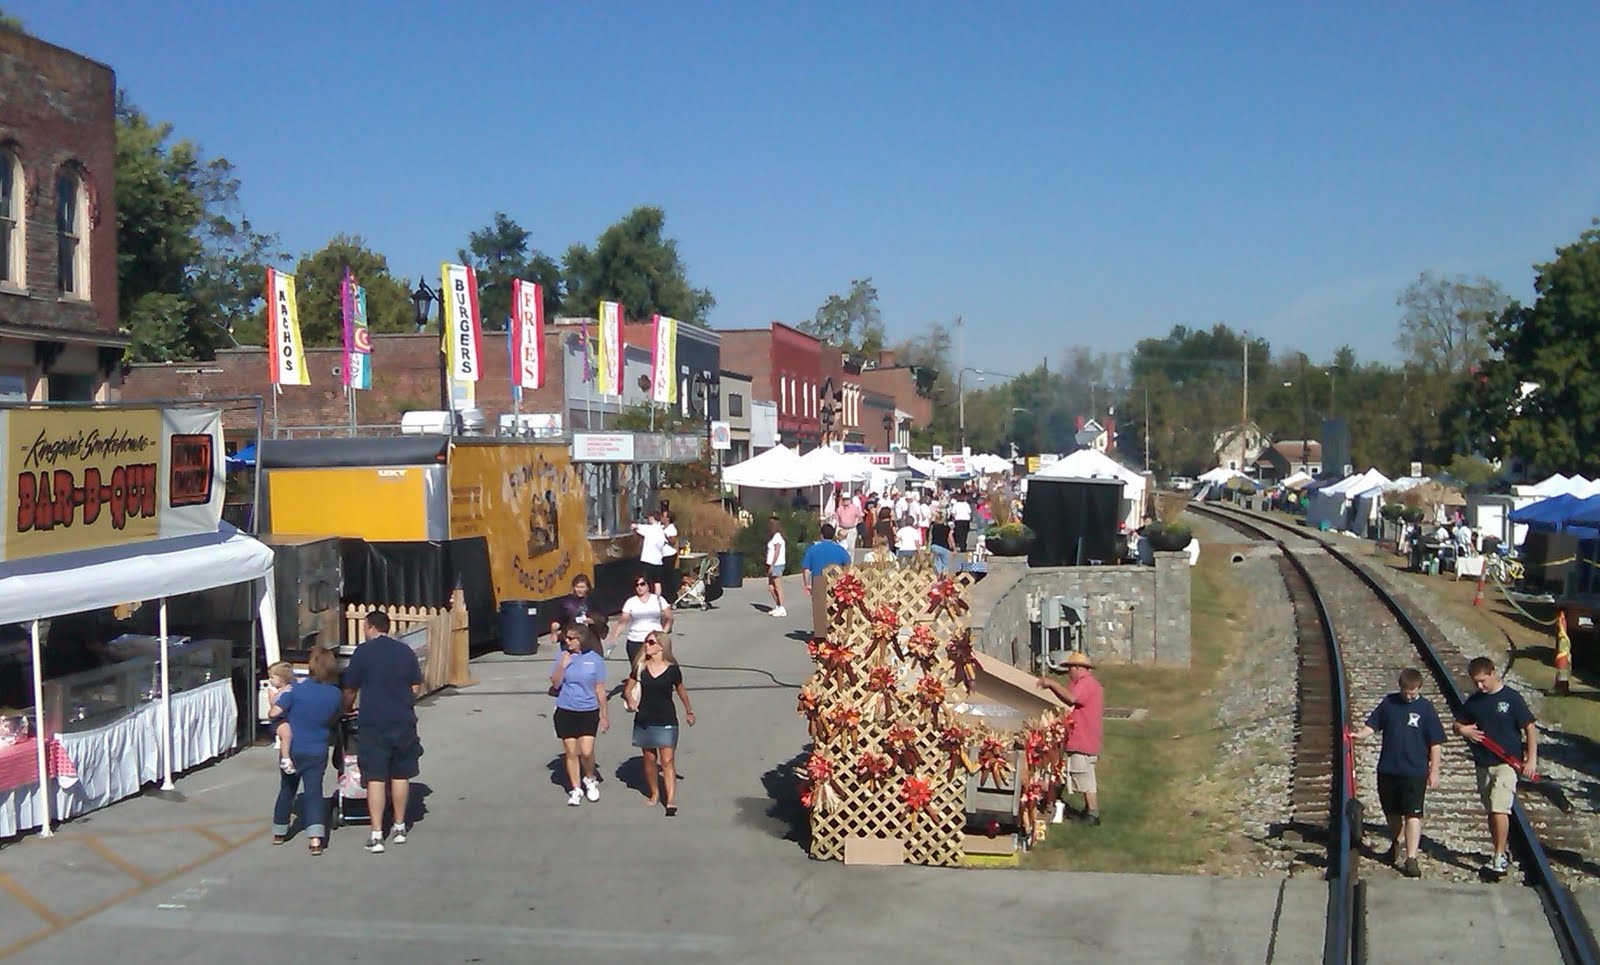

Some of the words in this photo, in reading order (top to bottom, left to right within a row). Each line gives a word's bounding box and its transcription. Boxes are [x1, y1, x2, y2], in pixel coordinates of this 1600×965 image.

[279, 290, 293, 372] NACHOS
[455, 279, 472, 374] BURGERS
[524, 292, 535, 380] FRIES
